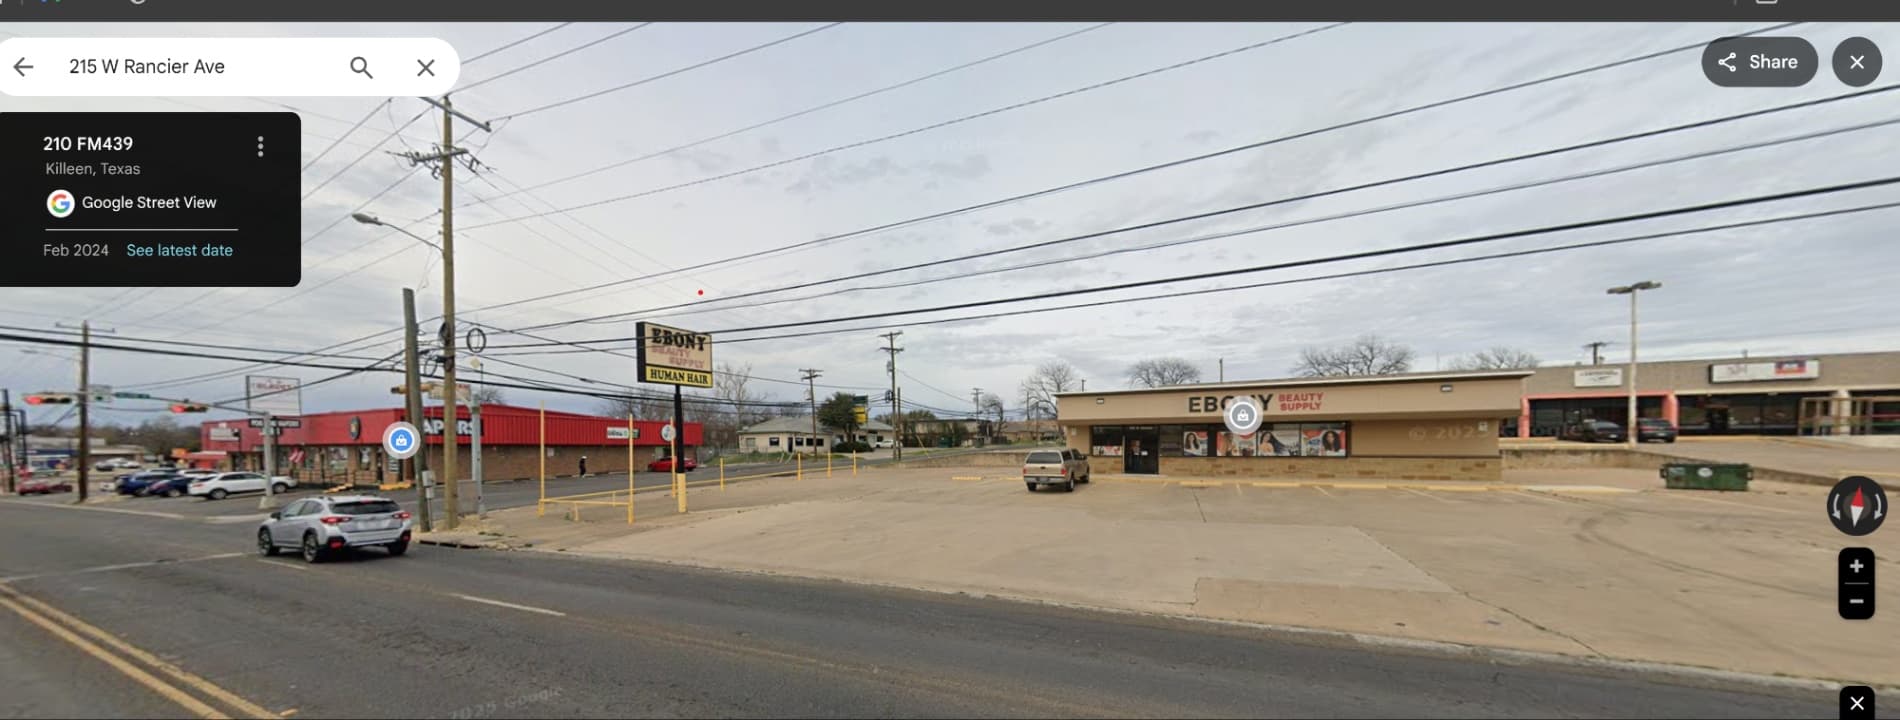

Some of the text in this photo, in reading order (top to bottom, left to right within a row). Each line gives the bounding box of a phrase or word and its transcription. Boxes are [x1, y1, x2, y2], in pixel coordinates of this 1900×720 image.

[651, 327, 706, 351] EBONY
[652, 345, 691, 357] BEAUTY
[669, 357, 705, 369] SUPPLY
[650, 369, 709, 384] HUMAN HAIR
[1278, 392, 1324, 402] BEAUTY
[1280, 402, 1322, 411] SUPPLY
